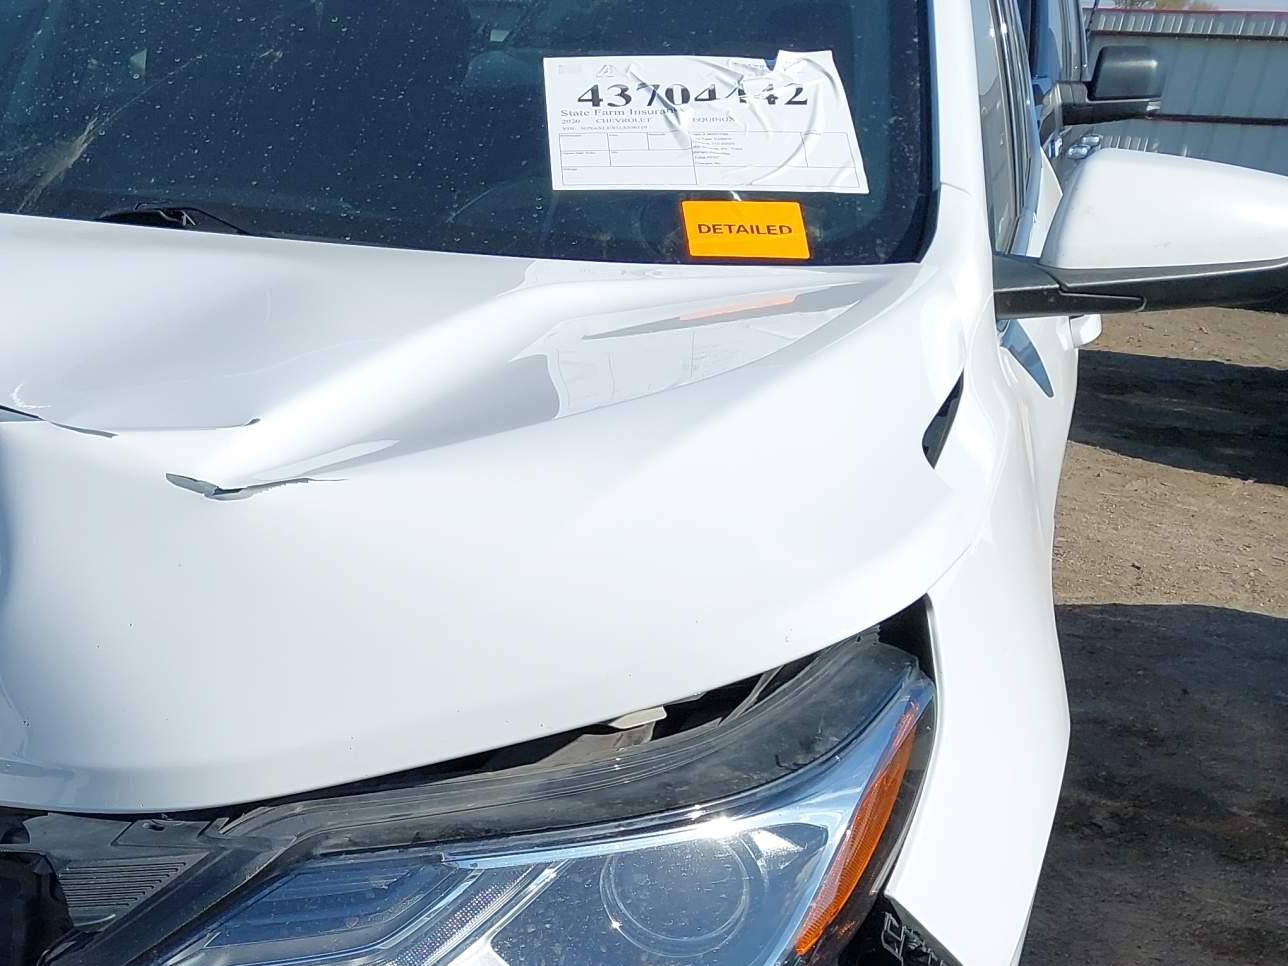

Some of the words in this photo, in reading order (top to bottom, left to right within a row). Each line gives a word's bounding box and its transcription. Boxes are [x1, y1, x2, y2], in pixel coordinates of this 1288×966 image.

[560, 108, 590, 117] State
[594, 108, 625, 117] Farm
[595, 116, 651, 124] CHEVROLET
[697, 223, 793, 236] DETAILED
